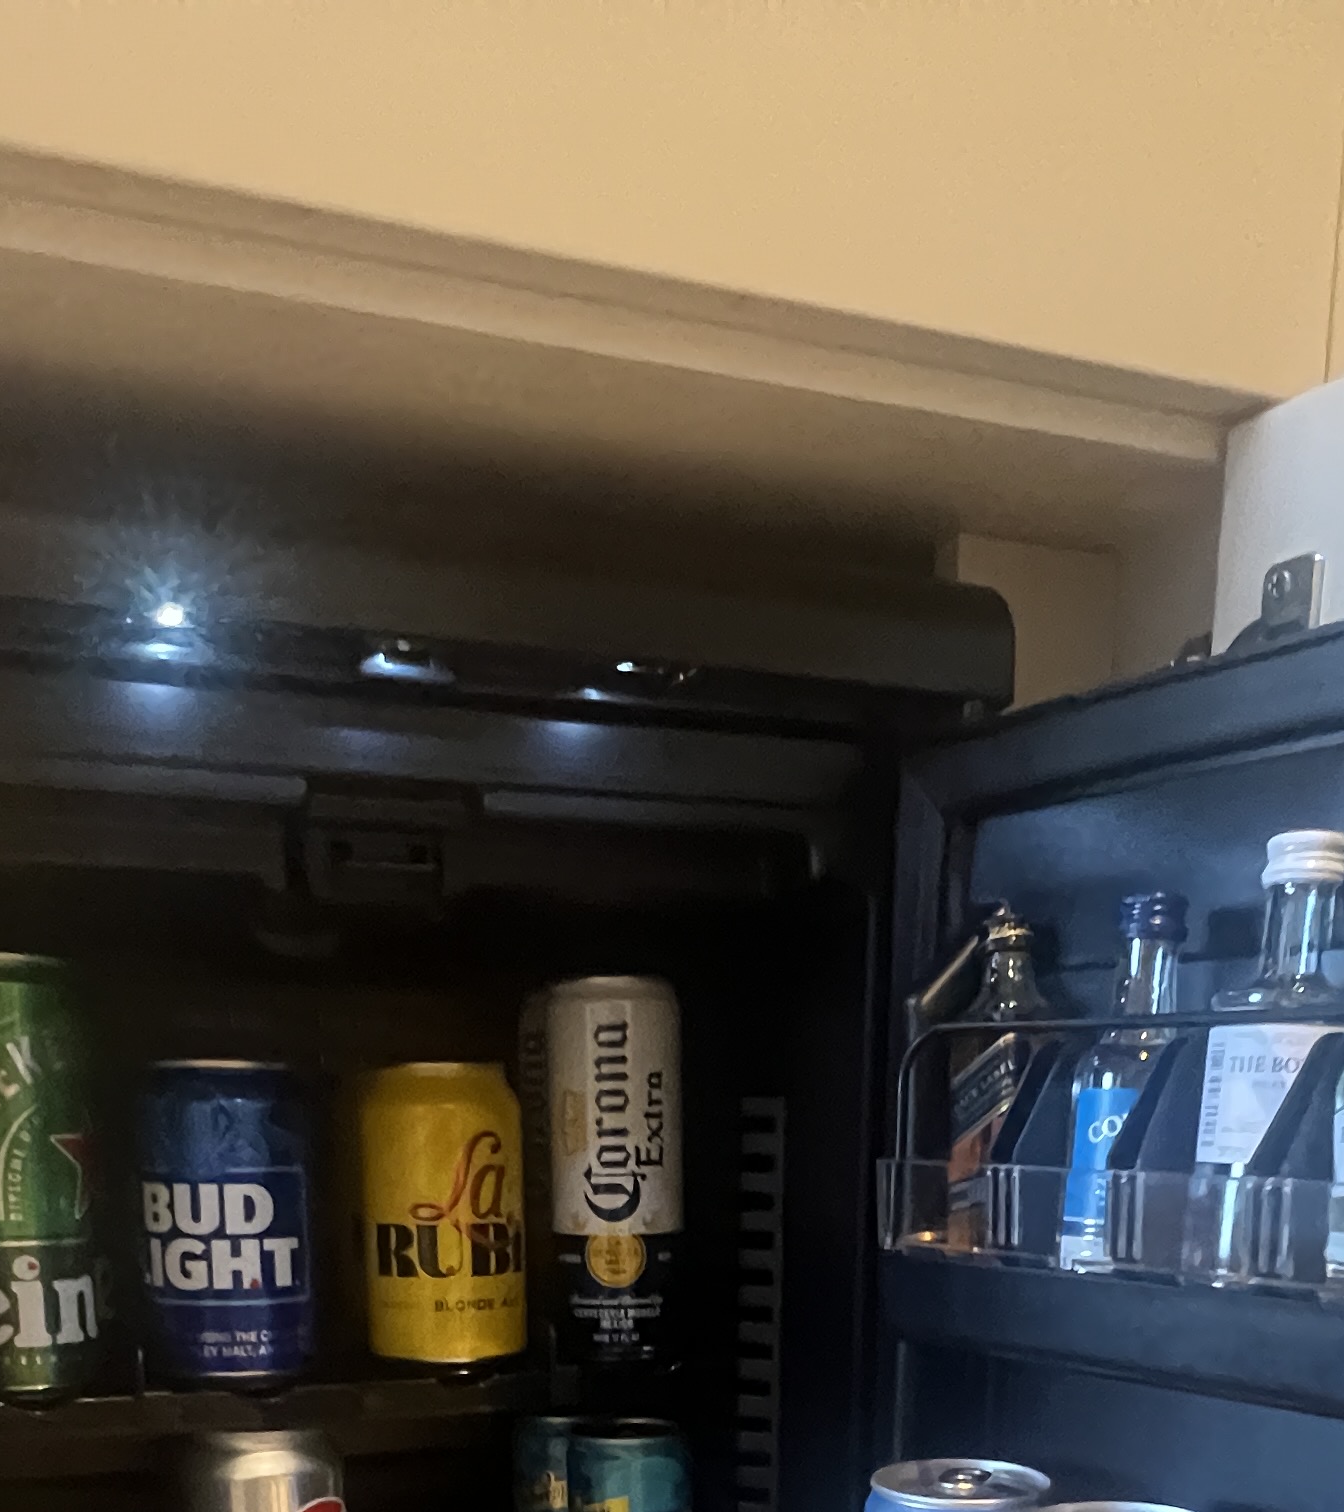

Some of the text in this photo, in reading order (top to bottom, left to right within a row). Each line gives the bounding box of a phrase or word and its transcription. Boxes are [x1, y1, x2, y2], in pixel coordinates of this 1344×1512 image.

[584, 1020, 646, 1223] Corona
[634, 1072, 665, 1168] Extra
[142, 1181, 275, 1236] BUD
